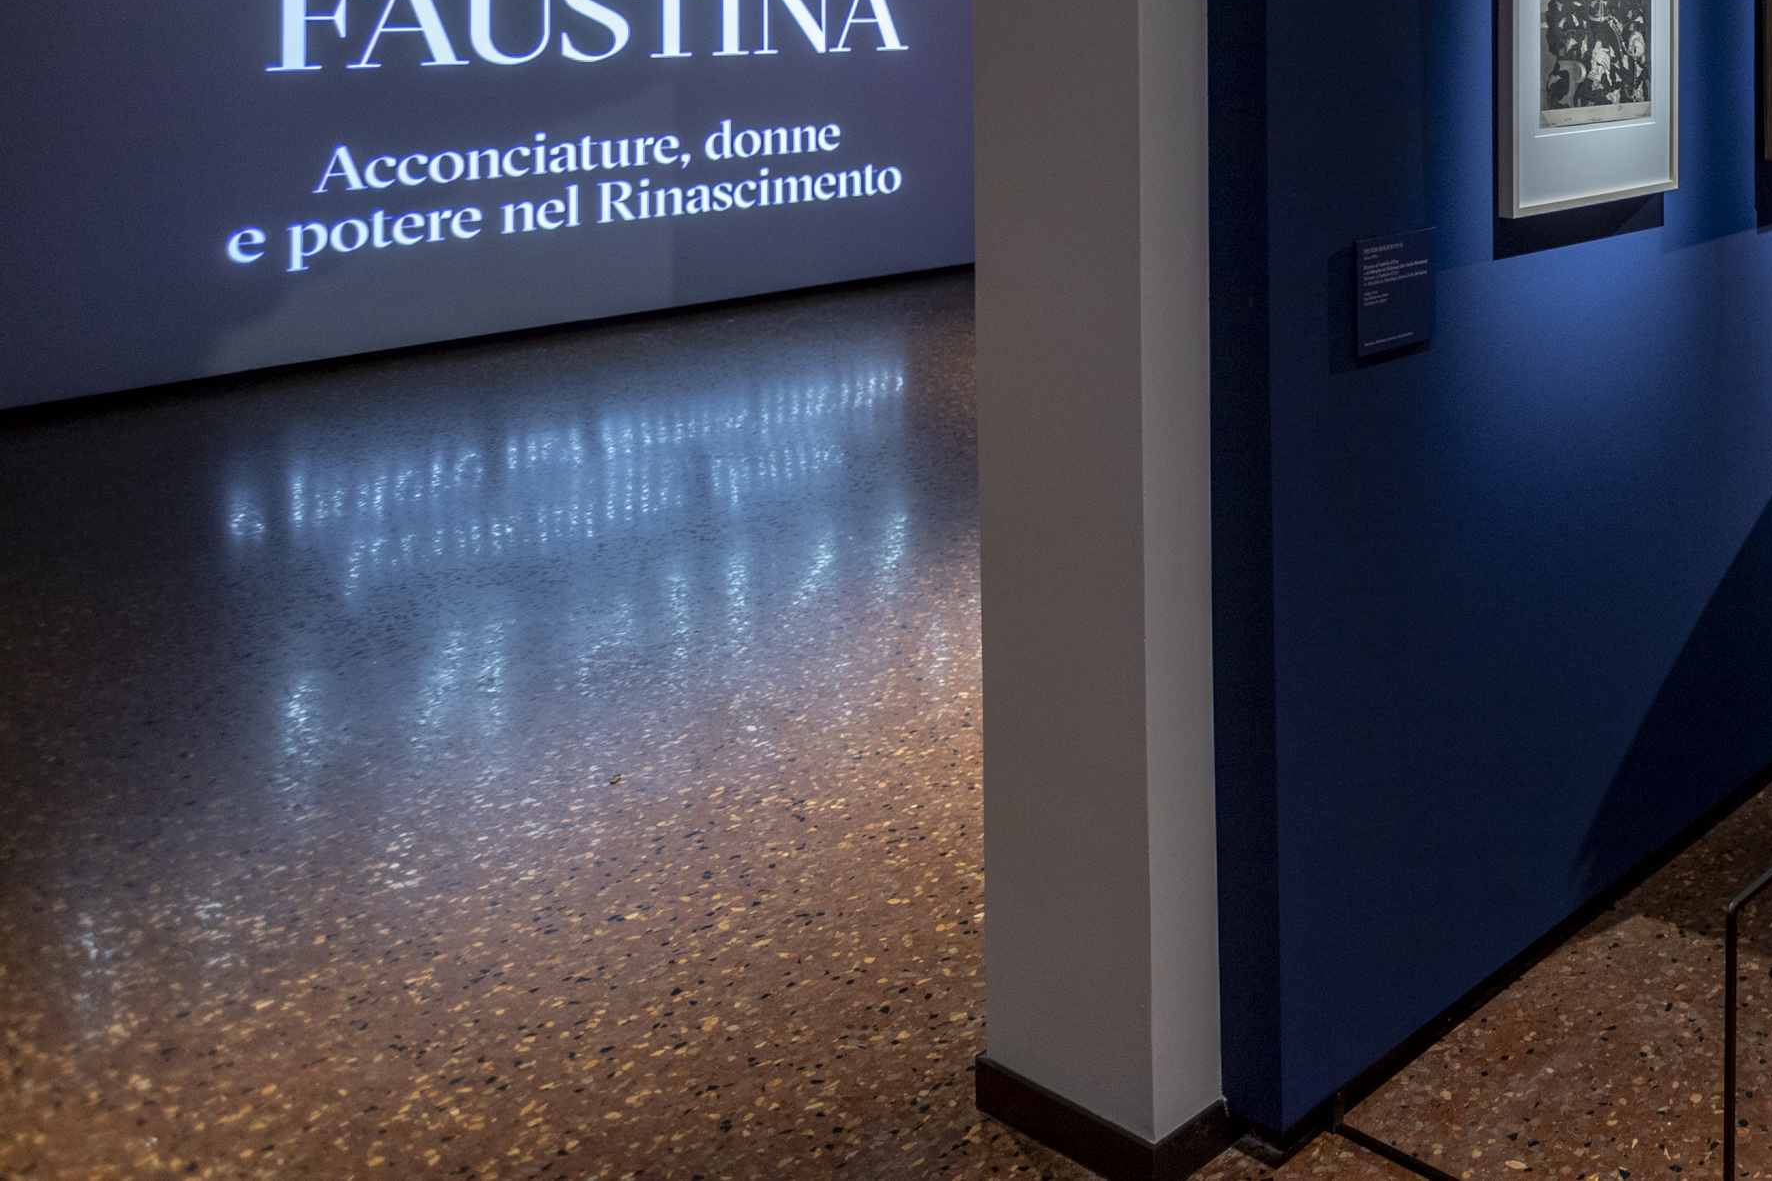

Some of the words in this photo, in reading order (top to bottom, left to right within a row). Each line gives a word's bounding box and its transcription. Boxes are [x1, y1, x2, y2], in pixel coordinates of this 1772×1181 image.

[312, 131, 692, 194] Acconciature,
[704, 118, 842, 161] donne
[225, 227, 267, 264] e
[286, 206, 483, 272] potere
[500, 183, 581, 235] nel
[596, 163, 903, 224] Rinascimento
